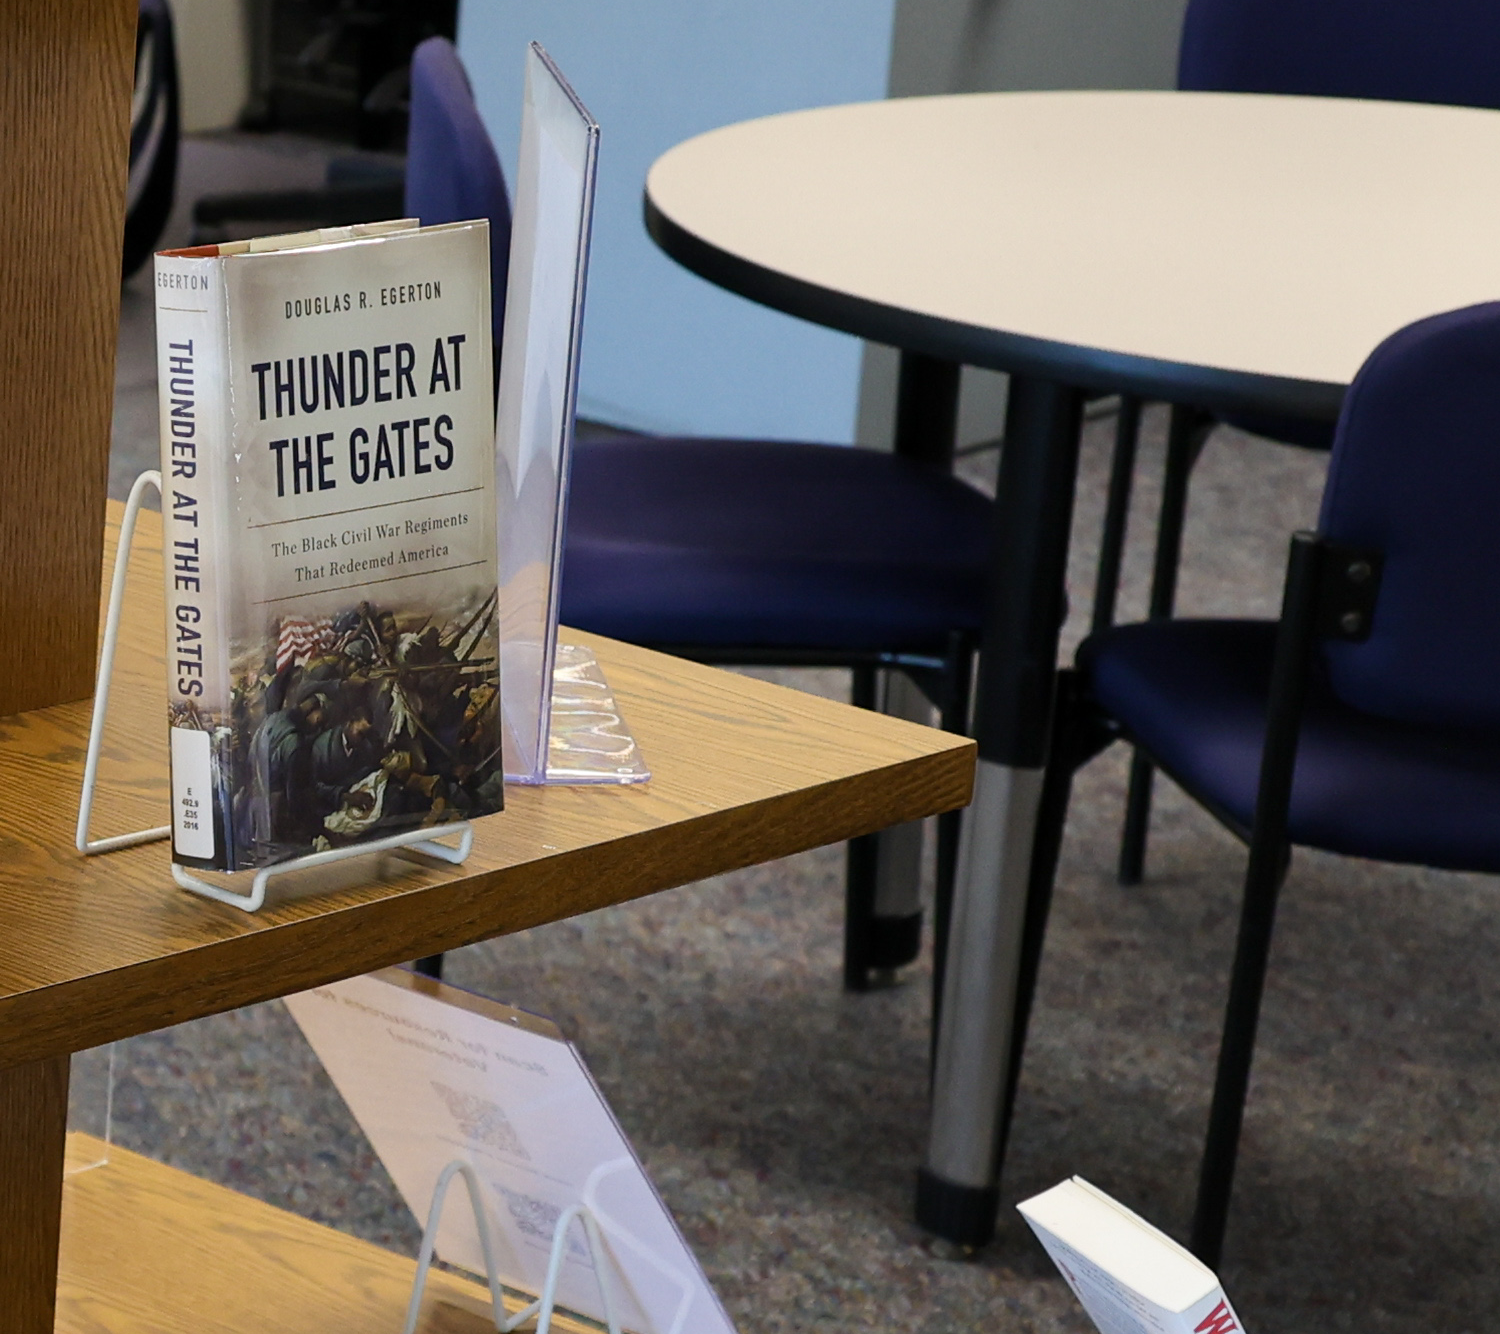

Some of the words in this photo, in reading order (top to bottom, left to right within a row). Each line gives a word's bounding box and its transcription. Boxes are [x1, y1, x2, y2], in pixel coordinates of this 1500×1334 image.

[157, 272, 208, 291] EGERTON
[285, 292, 350, 319] DOUGLAS
[359, 291, 373, 308] R.
[381, 281, 442, 306] EGERTON
[251, 342, 417, 421] THUNDER
[429, 334, 466, 395] AT
[169, 339, 197, 479] THUNDER
[269, 432, 336, 497] THE
[350, 414, 454, 484] GATES
[172, 492, 198, 528] AT
[272, 543, 296, 557] The
[302, 534, 337, 552] Black
[341, 528, 371, 545] Civil
[376, 524, 400, 539] War
[405, 513, 468, 535] Regiments
[174, 538, 200, 592] THE
[295, 566, 324, 582] That
[330, 552, 394, 576] Redeemed
[398, 545, 449, 564] America
[175, 606, 204, 697] GATES
